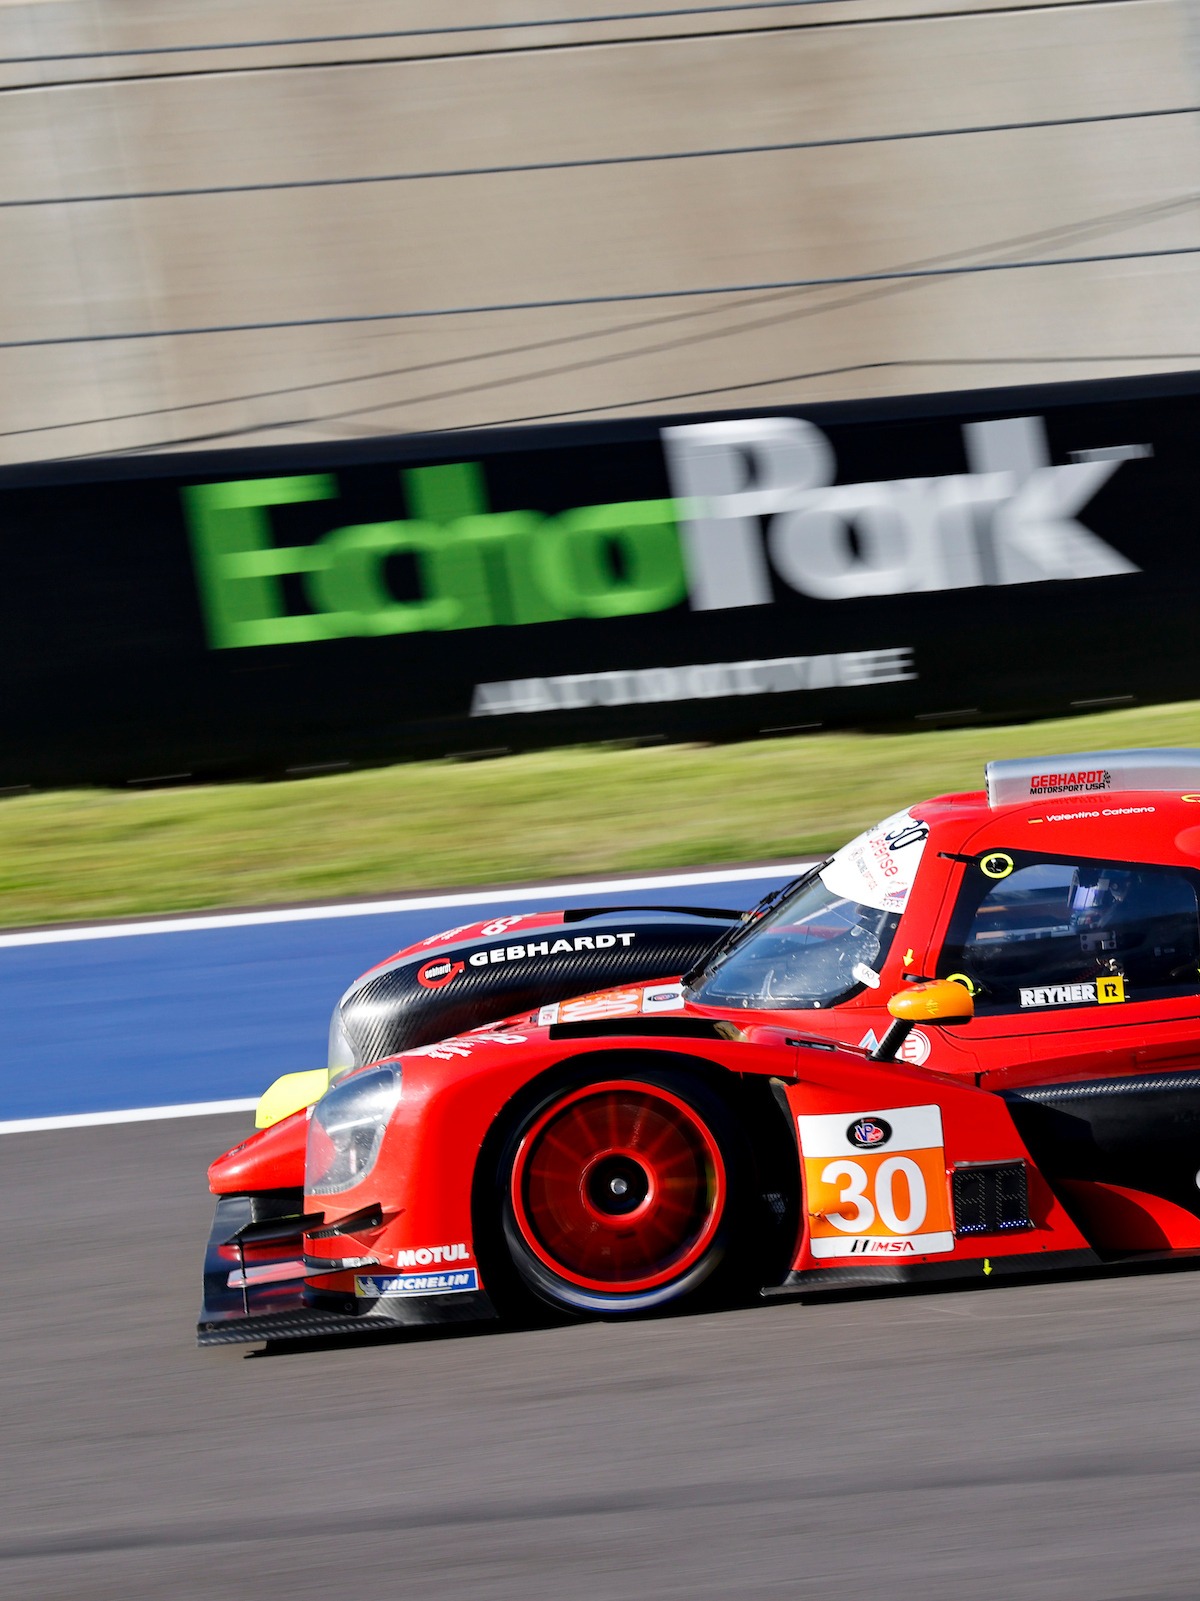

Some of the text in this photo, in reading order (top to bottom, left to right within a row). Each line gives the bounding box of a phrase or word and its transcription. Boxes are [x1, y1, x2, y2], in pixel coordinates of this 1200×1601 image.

[180, 416, 1147, 650] EchoPark
[1030, 769, 1105, 789] GEBHARDT
[1030, 782, 1106, 795] MOTORSPORT USA
[1046, 805, 1155, 822] Valentino Catalano
[885, 820, 930, 850] 30
[469, 932, 636, 967] GEBHARDT
[1020, 983, 1097, 1008] REYHER
[820, 1155, 927, 1235] 30
[397, 1243, 470, 1267] MOTUL
[870, 1241, 915, 1253] IMSA
[382, 1273, 470, 1290] MICHELIN
